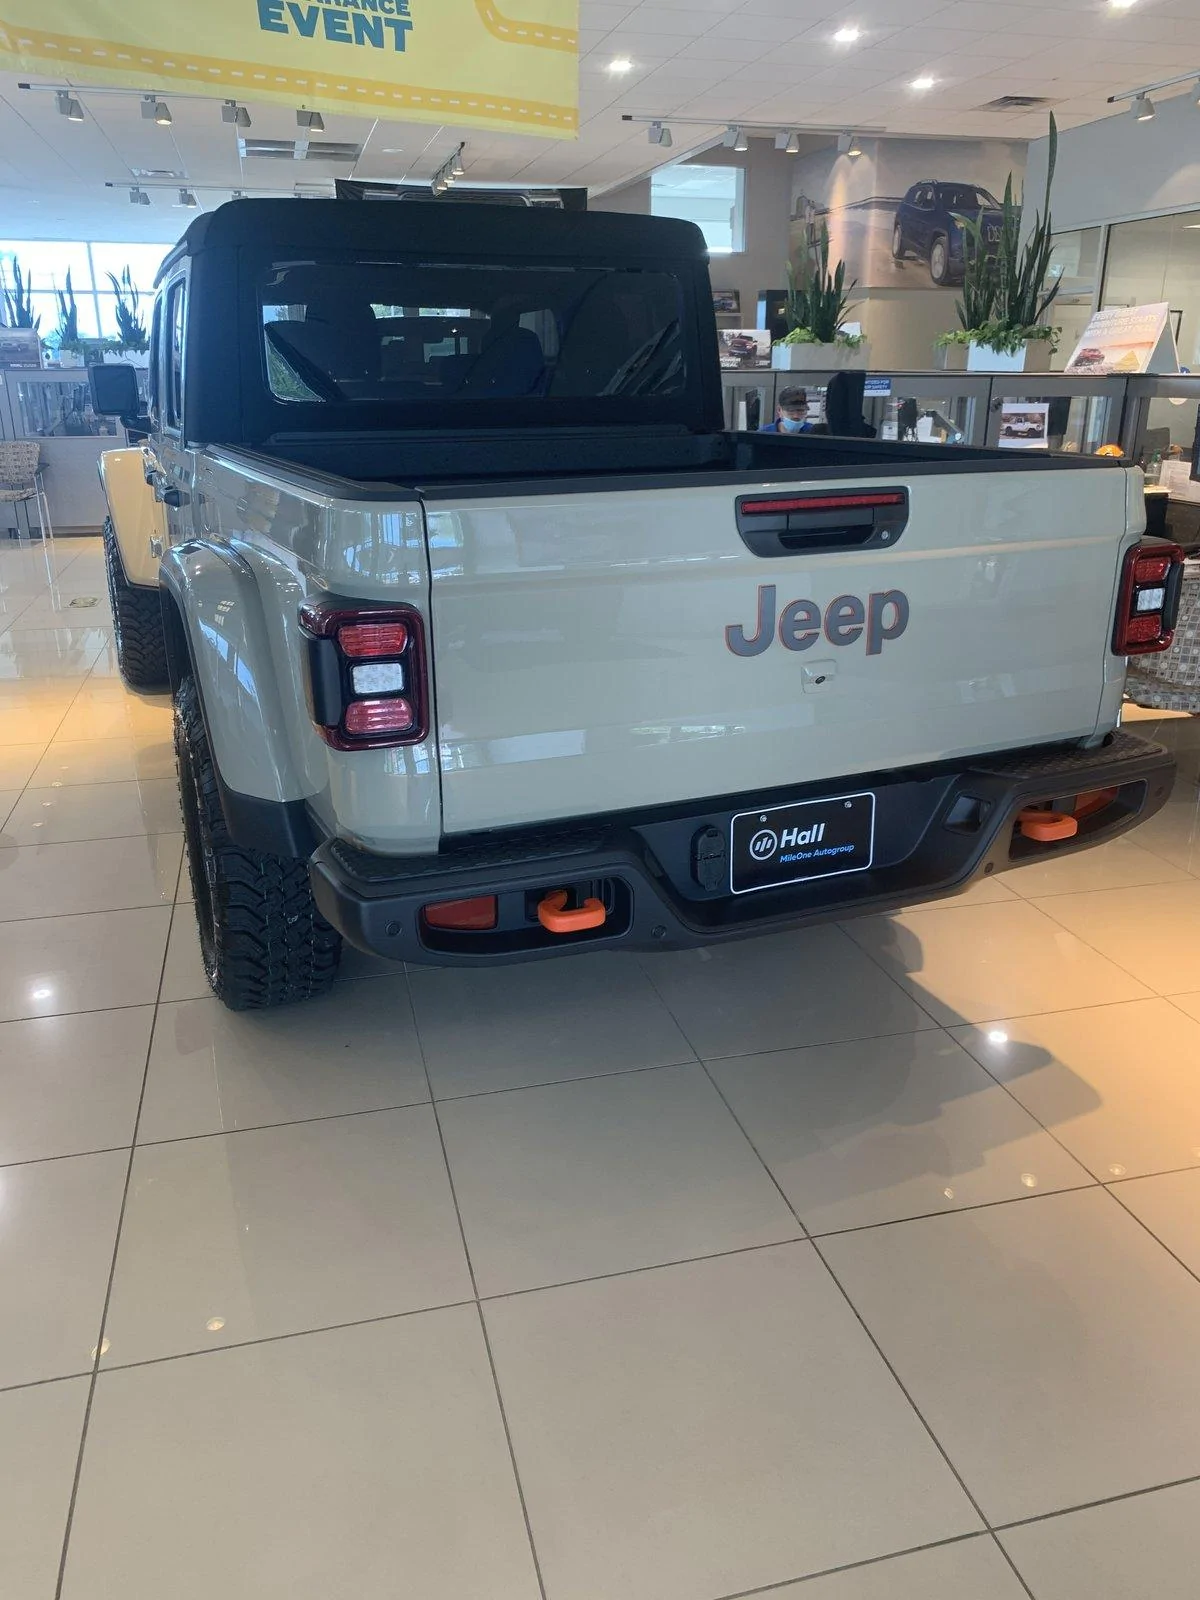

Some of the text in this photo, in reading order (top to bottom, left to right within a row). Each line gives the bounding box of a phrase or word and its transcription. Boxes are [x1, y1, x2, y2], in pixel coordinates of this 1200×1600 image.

[257, 0, 413, 52] EVENT
[725, 584, 910, 657] Jeep
[780, 823, 825, 848] Hall
[780, 844, 854, 863] MileOne Autogroup
